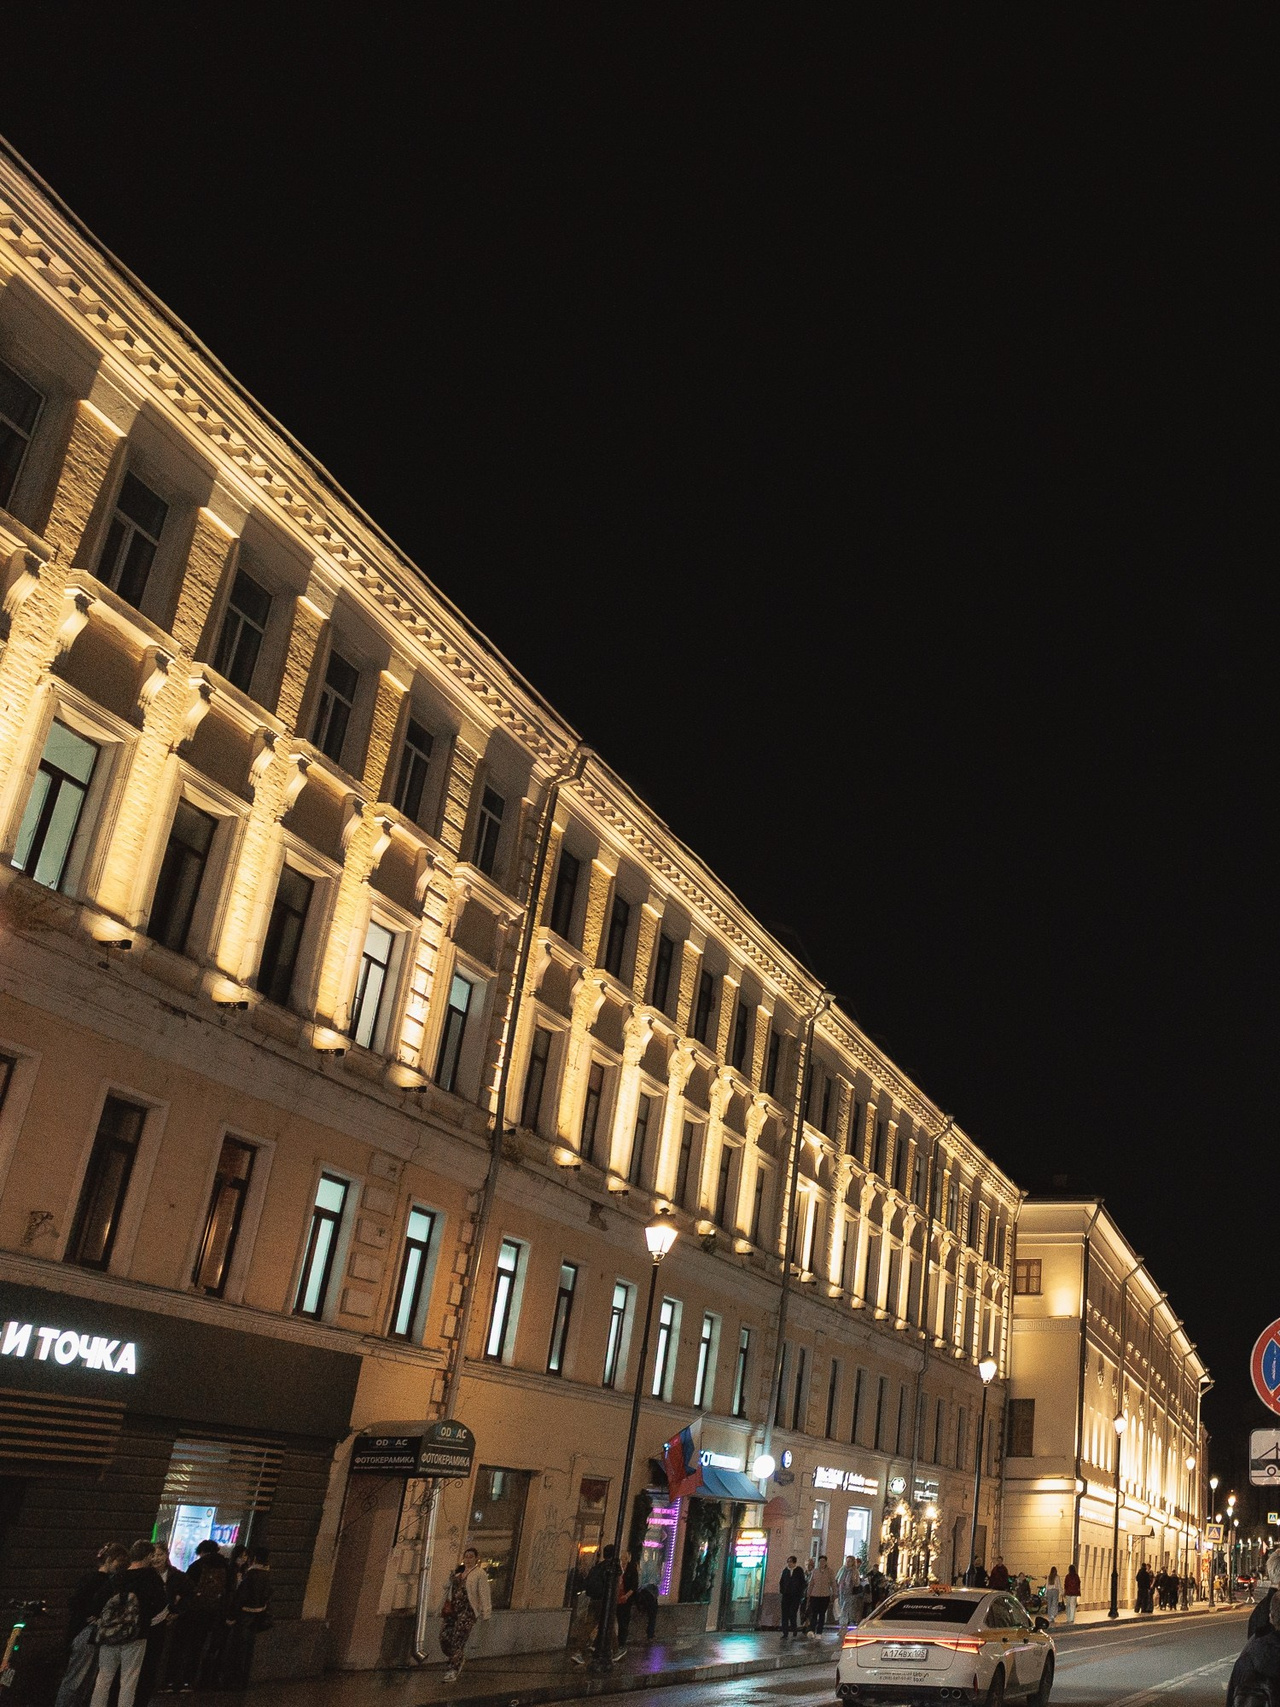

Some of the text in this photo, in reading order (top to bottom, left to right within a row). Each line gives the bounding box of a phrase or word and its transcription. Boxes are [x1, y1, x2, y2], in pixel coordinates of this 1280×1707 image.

[1, 1321, 136, 1374] И ТОЧКА
[355, 1456, 415, 1464] ФОТОКЕРАМИКА
[421, 1452, 470, 1467] ФОТОКЕРАМИКА
